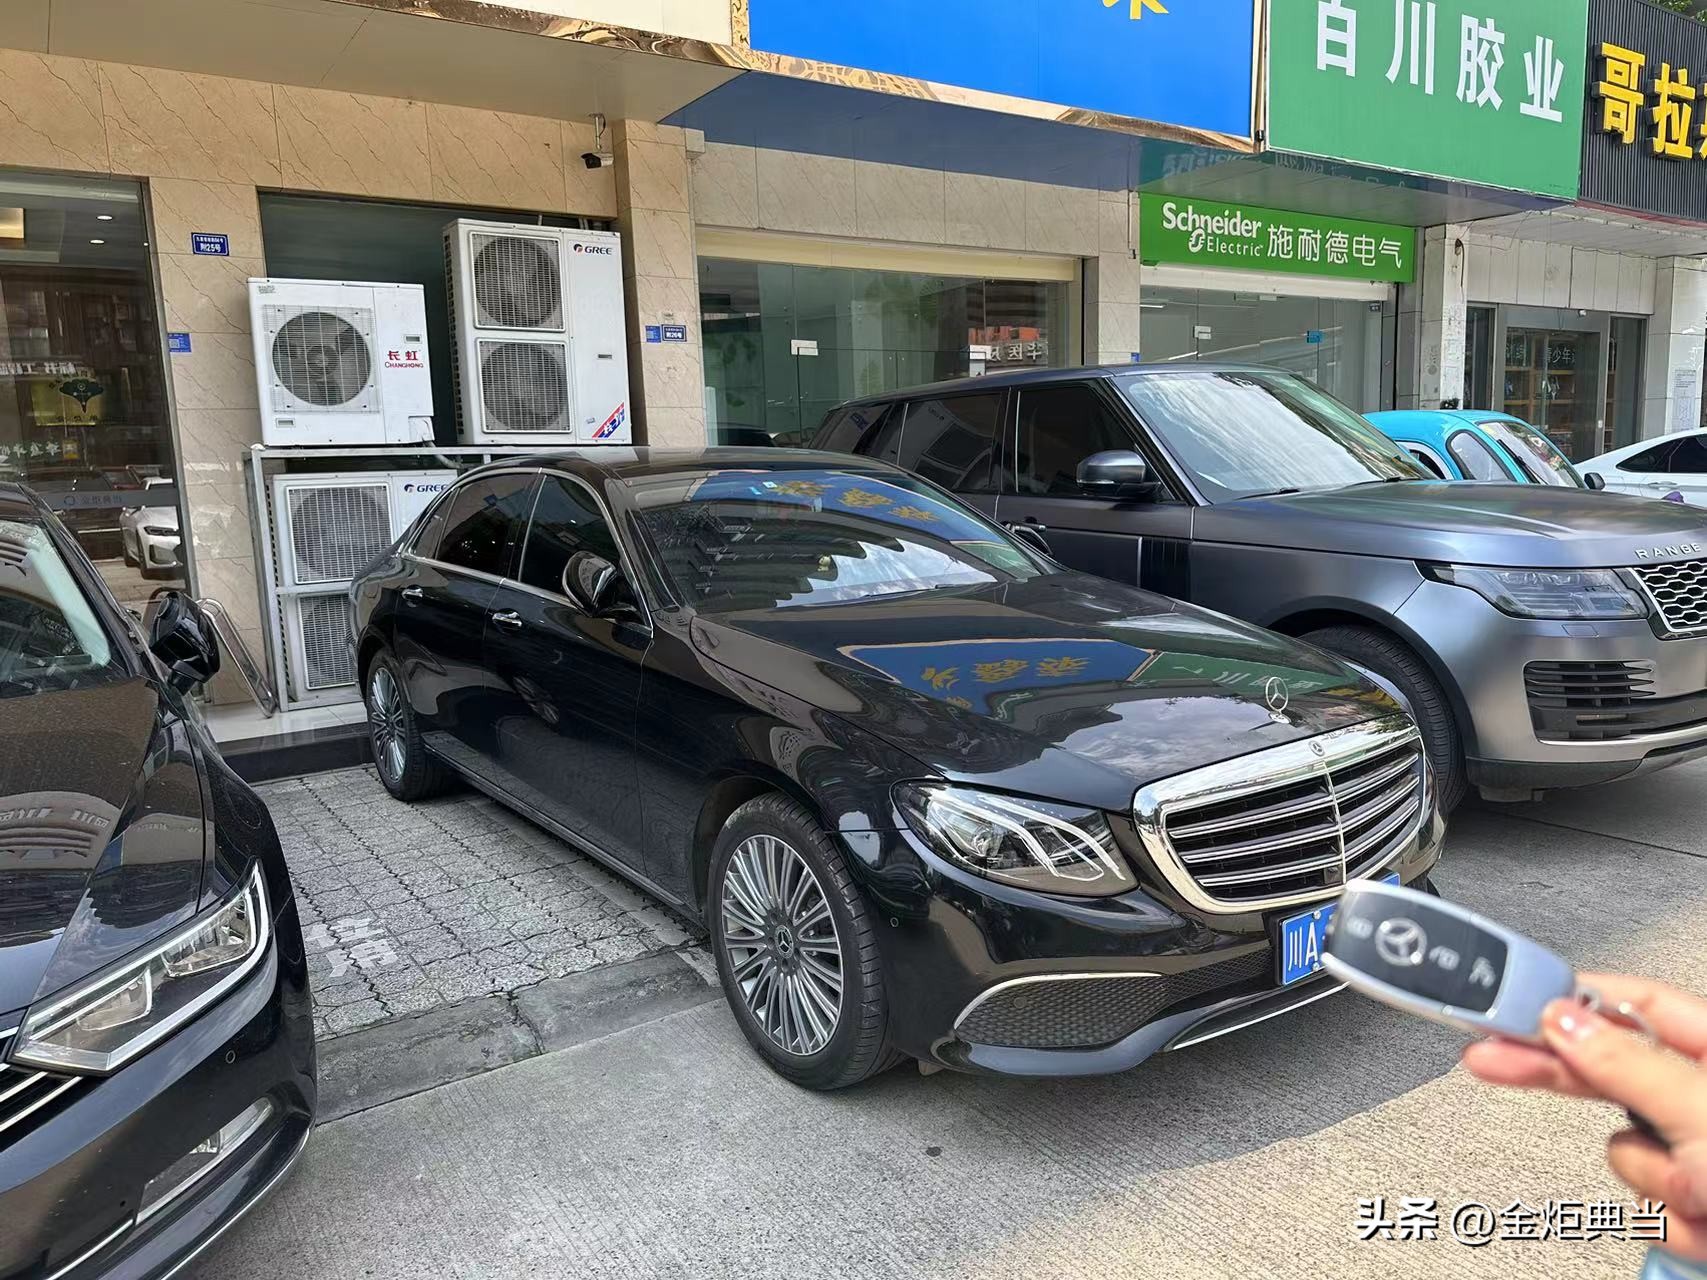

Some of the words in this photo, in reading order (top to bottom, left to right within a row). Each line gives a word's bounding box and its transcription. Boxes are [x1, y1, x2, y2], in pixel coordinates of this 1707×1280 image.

[1317, 0, 1565, 123] 百川胶业
[1162, 201, 1262, 239] Schneider
[584, 245, 613, 256] GREE
[1207, 236, 1261, 257] Electric
[1267, 223, 1402, 269] 施耐德电气
[387, 350, 418, 361] 长虹
[1635, 542, 1702, 559] RANGE
